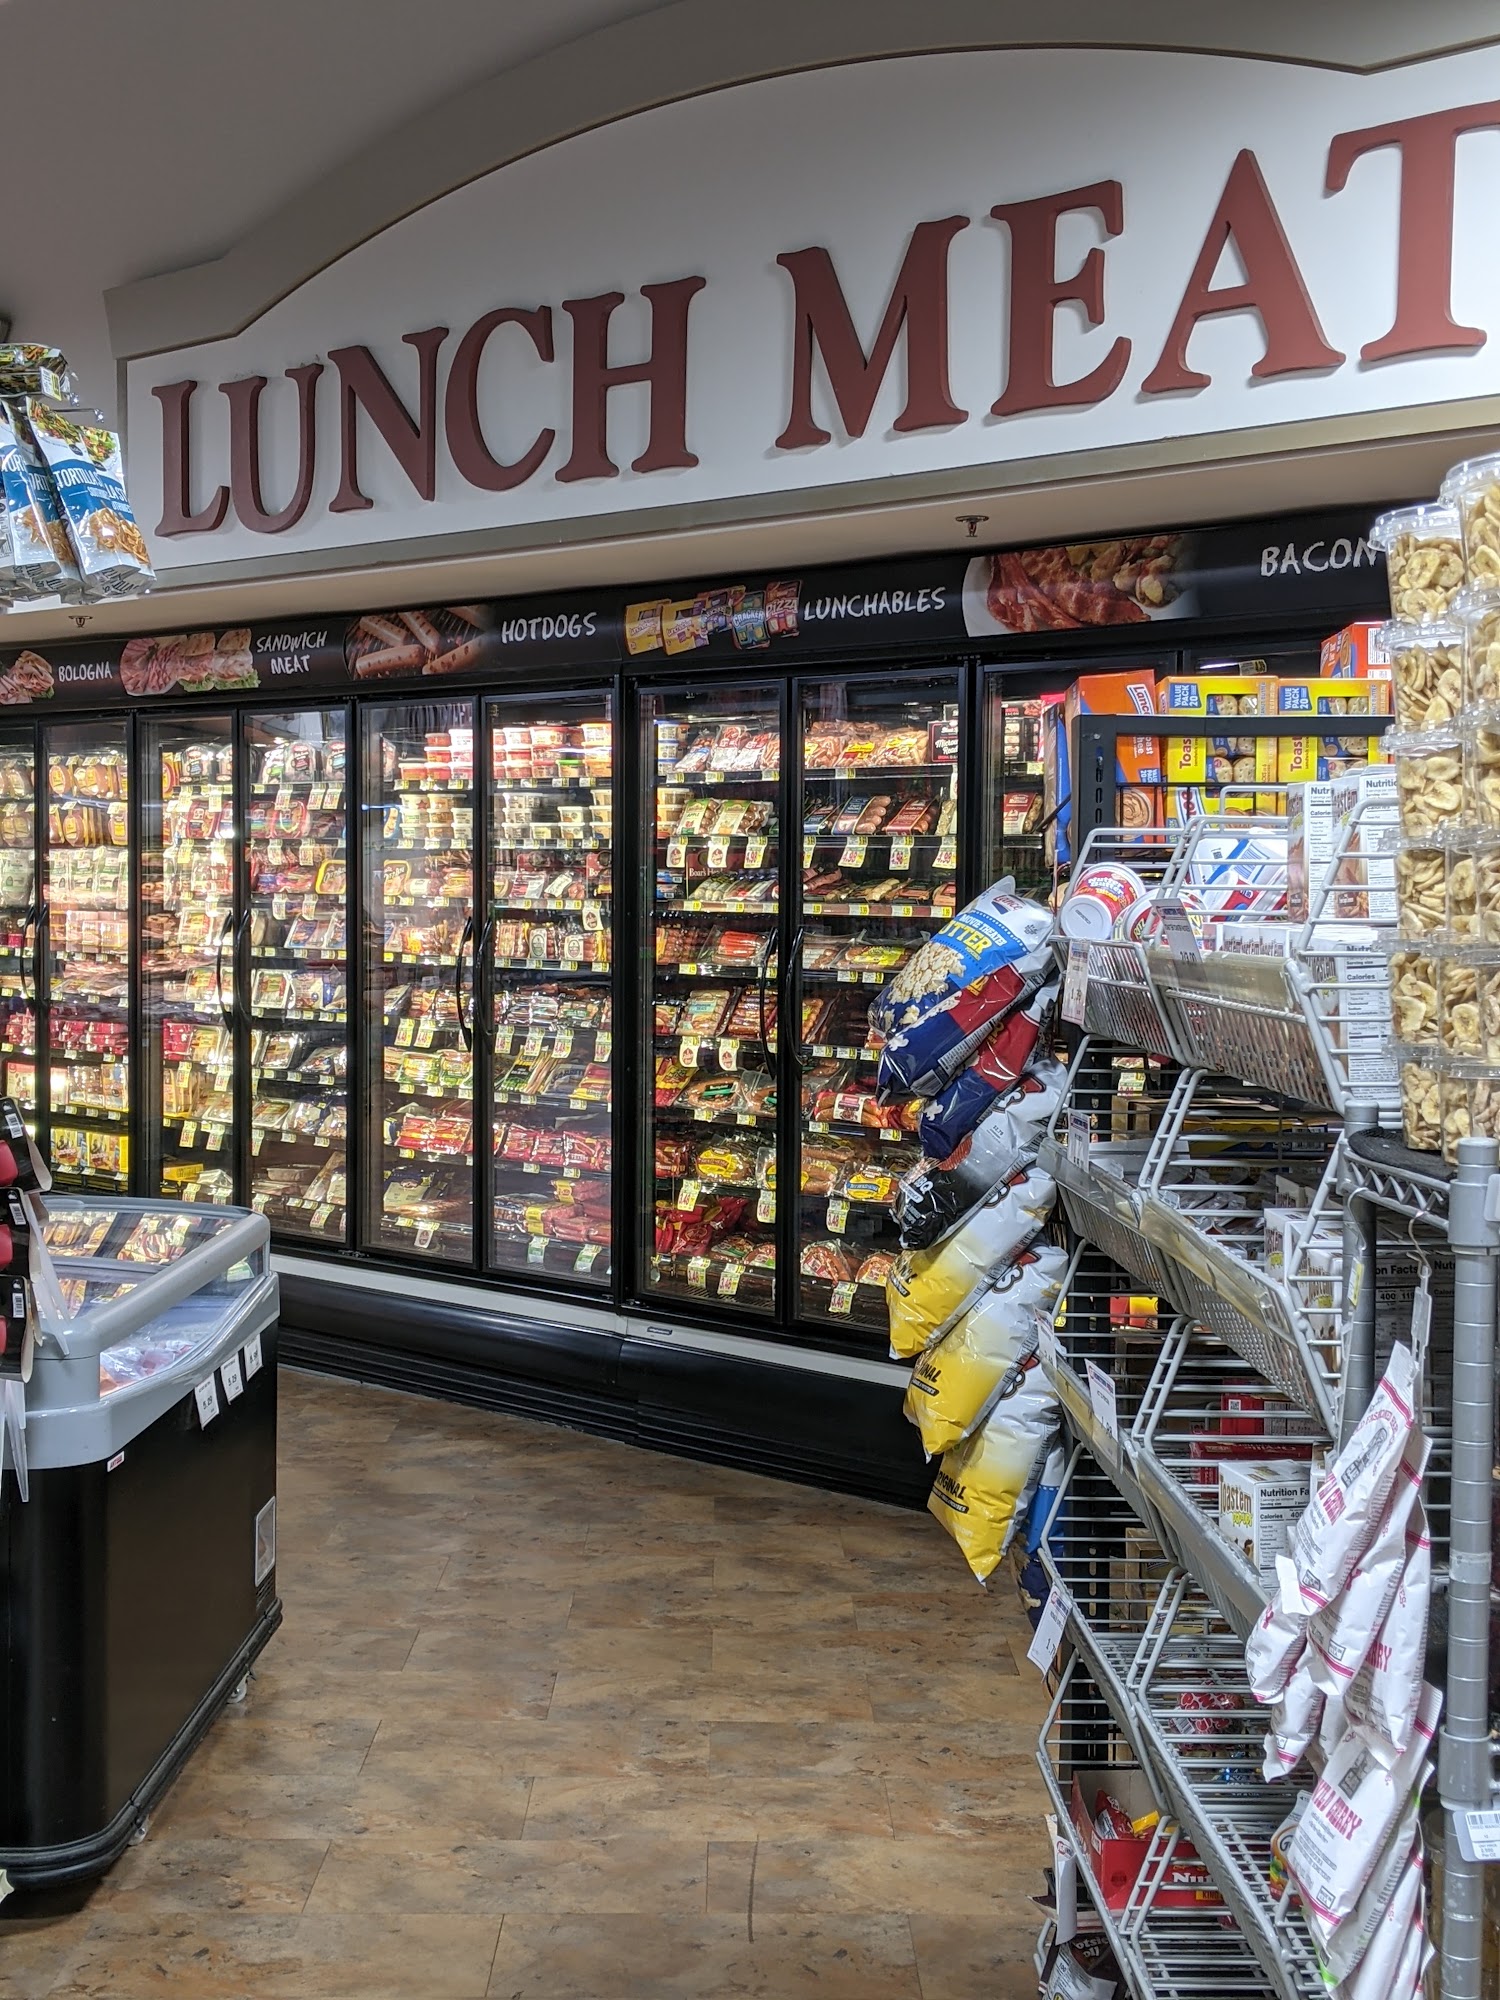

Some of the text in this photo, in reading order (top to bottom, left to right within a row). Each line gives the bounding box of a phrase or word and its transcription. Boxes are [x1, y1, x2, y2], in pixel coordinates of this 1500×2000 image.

[152, 102, 1500, 537] LUNCH MEAT
[1259, 538, 1379, 577] BACON
[803, 587, 946, 621] LUNCHABLES
[501, 612, 597, 644] HOTDOGS
[256, 631, 327, 653] SANDWICH
[58, 661, 113, 681] BOLOGNA
[271, 655, 310, 675] MEAT
[1174, 684, 1182, 707] VALUE
[1181, 684, 1190, 707] PACK
[1189, 696, 1198, 707] 20
[1284, 687, 1292, 710] VALUE
[1291, 687, 1300, 709] PACK
[1299, 698, 1309, 709] 20
[689, 867, 707, 877] Boar's
[1088, 876, 1124, 889] Nutter
[1390, 1265, 1418, 1275] Facts
[1260, 1488, 1298, 1498] Nutrition
